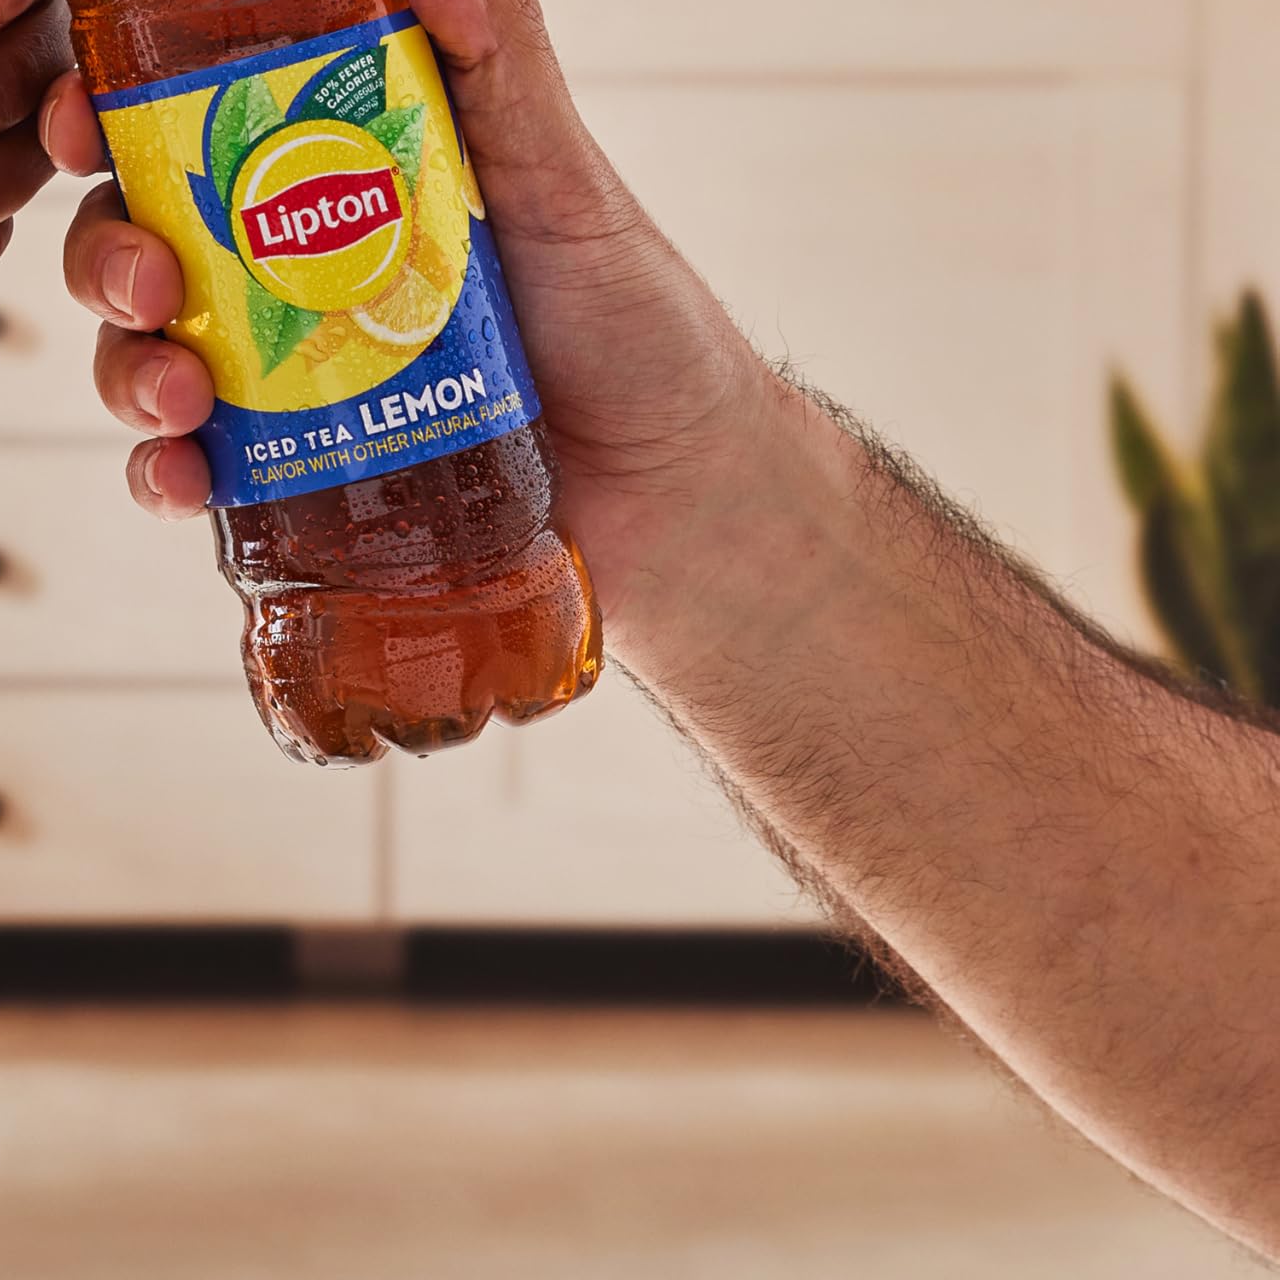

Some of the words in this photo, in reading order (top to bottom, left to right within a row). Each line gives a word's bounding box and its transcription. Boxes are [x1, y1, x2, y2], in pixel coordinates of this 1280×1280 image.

[314, 79, 339, 103] 50%
[338, 54, 375, 82] FEWER
[326, 66, 378, 109] CALORIES
[335, 97, 355, 119] THAN
[353, 77, 385, 103] REGULAR
[256, 186, 389, 246] Lipton
[245, 437, 297, 464] ICED
[304, 423, 354, 450] TEA
[359, 367, 487, 436] LEMON
[251, 459, 308, 485] FLAVOR
[307, 449, 351, 473] WITH
[353, 431, 411, 462] OTHER
[411, 412, 481, 446] NATURAL
[479, 391, 524, 420] FLAVORS
